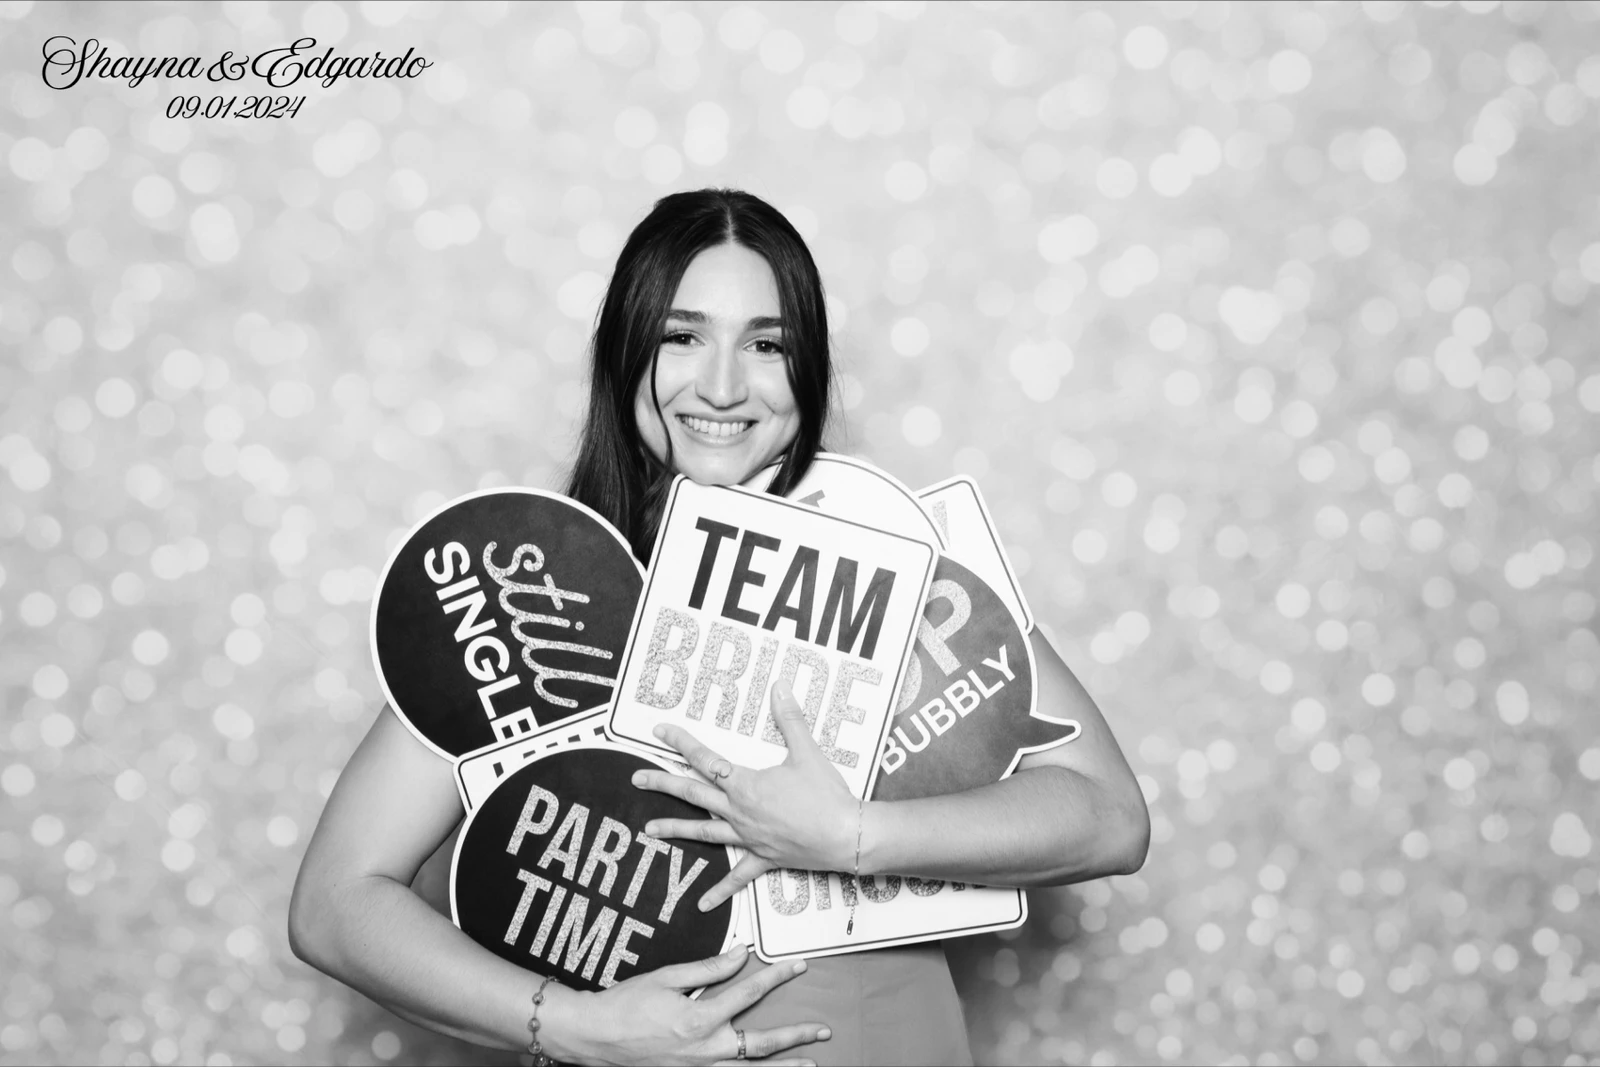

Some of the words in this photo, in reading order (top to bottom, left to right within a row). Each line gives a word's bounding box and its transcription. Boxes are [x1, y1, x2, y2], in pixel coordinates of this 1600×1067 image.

[424, 541, 539, 742] SINGLE
[687, 516, 897, 661] TEAM
[634, 606, 883, 769] BRIDE
[880, 644, 1016, 776] BUBBLY
[505, 784, 710, 924] PARTY
[503, 868, 656, 990] TIME
